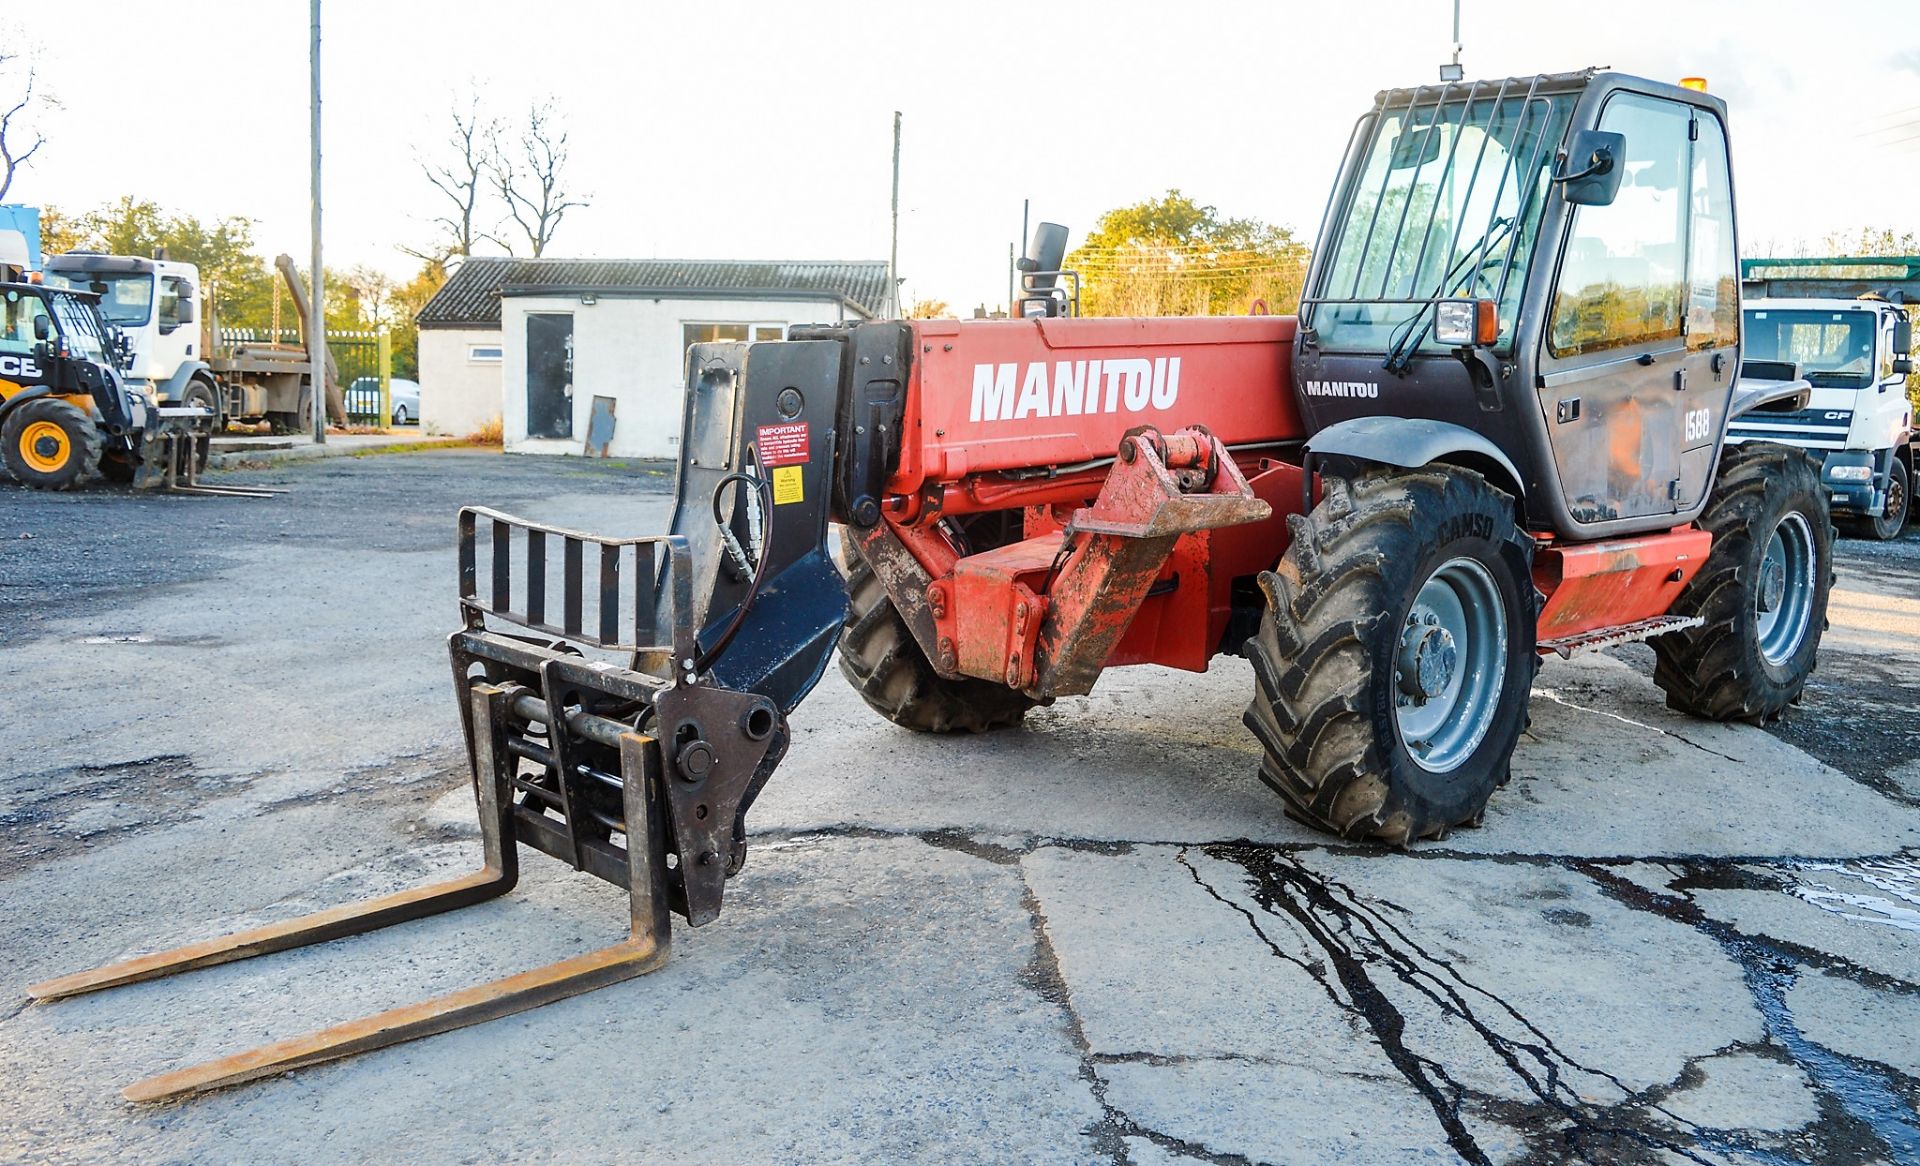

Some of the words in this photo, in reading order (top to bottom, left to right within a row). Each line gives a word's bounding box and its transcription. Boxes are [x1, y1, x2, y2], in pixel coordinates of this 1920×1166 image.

[969, 357, 1182, 422] MANITOU
[1306, 381, 1378, 398] MANITOU
[1685, 408, 1710, 442] 1588
[1824, 411, 1851, 420] CF
[760, 425, 806, 435] IMPORTANT
[1438, 512, 1494, 548] CAMSO
